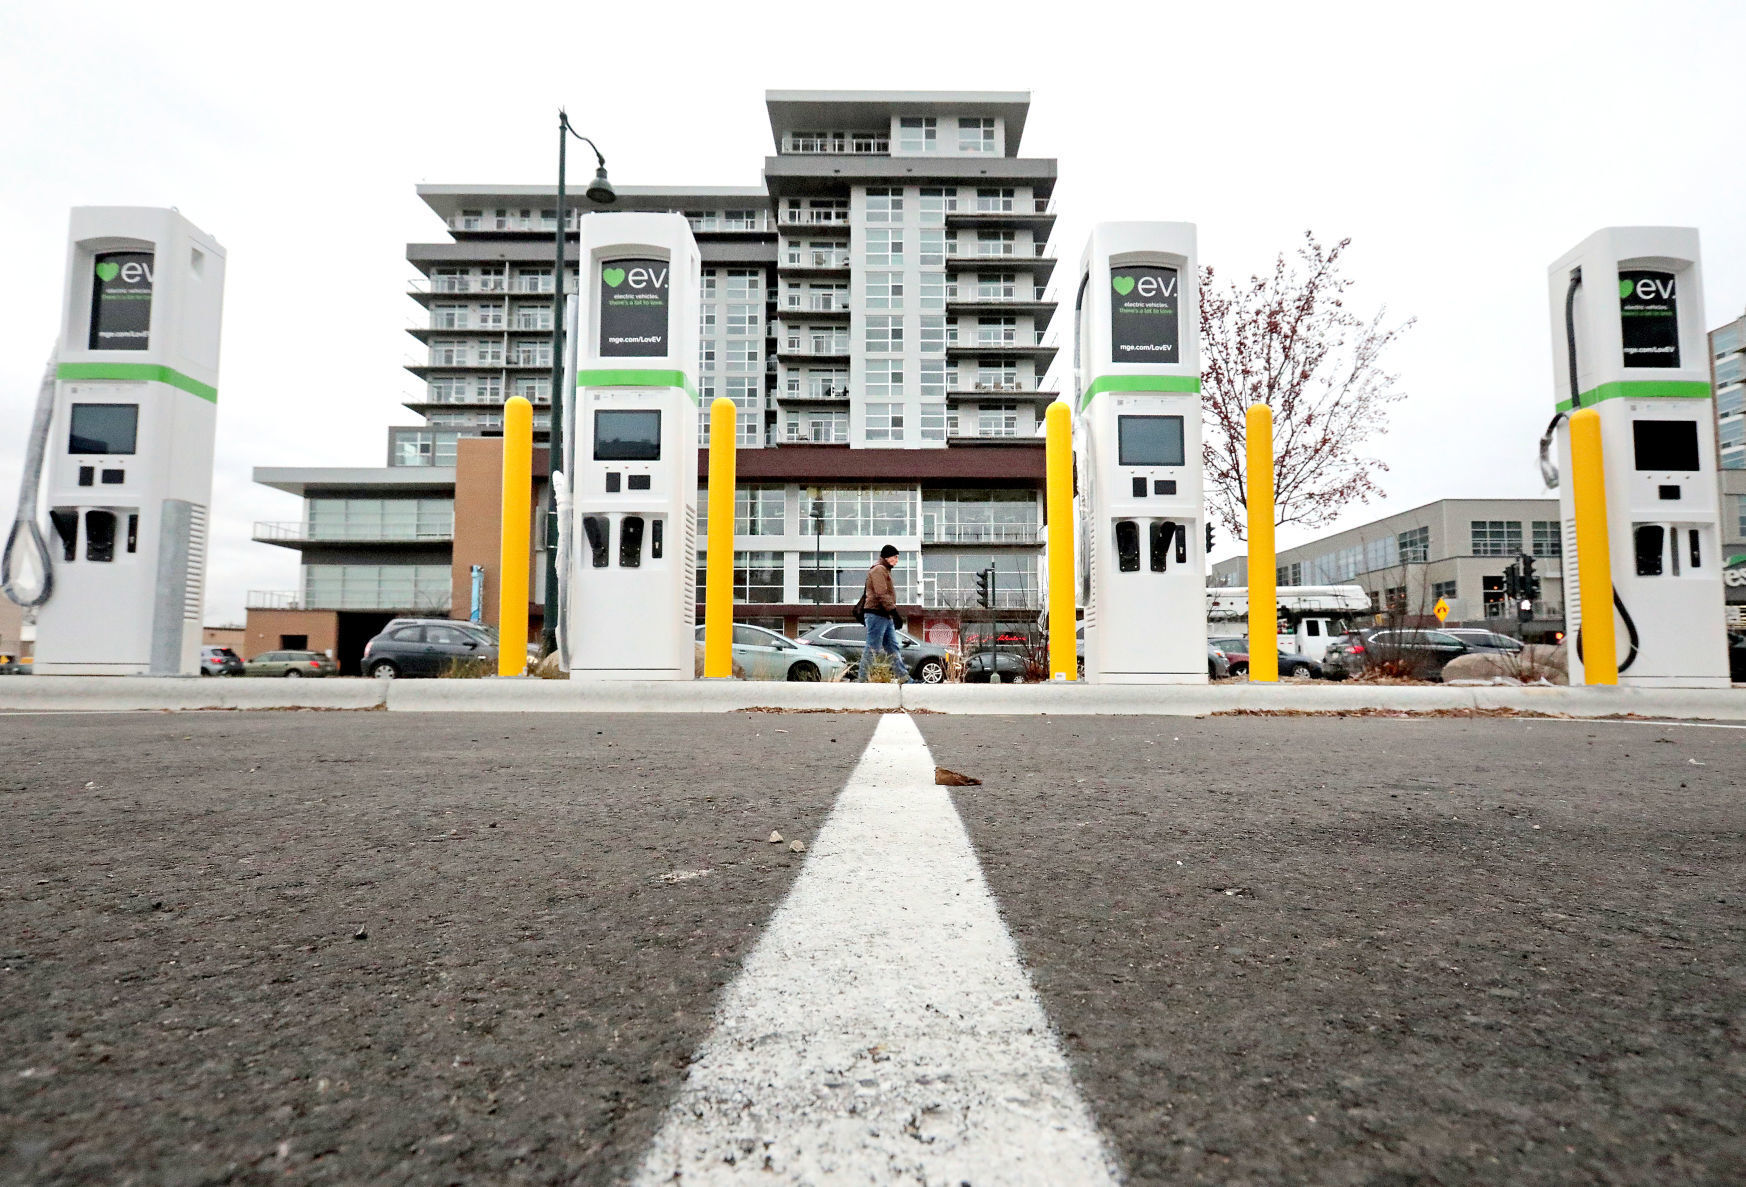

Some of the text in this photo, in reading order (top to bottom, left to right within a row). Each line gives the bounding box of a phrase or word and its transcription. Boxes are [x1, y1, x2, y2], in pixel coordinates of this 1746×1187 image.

[628, 268, 669, 289] ev.
[1137, 276, 1178, 297] ev.
[608, 335, 662, 344] mge.com/LovEV
[1120, 344, 1173, 352] mge.com/LovEV
